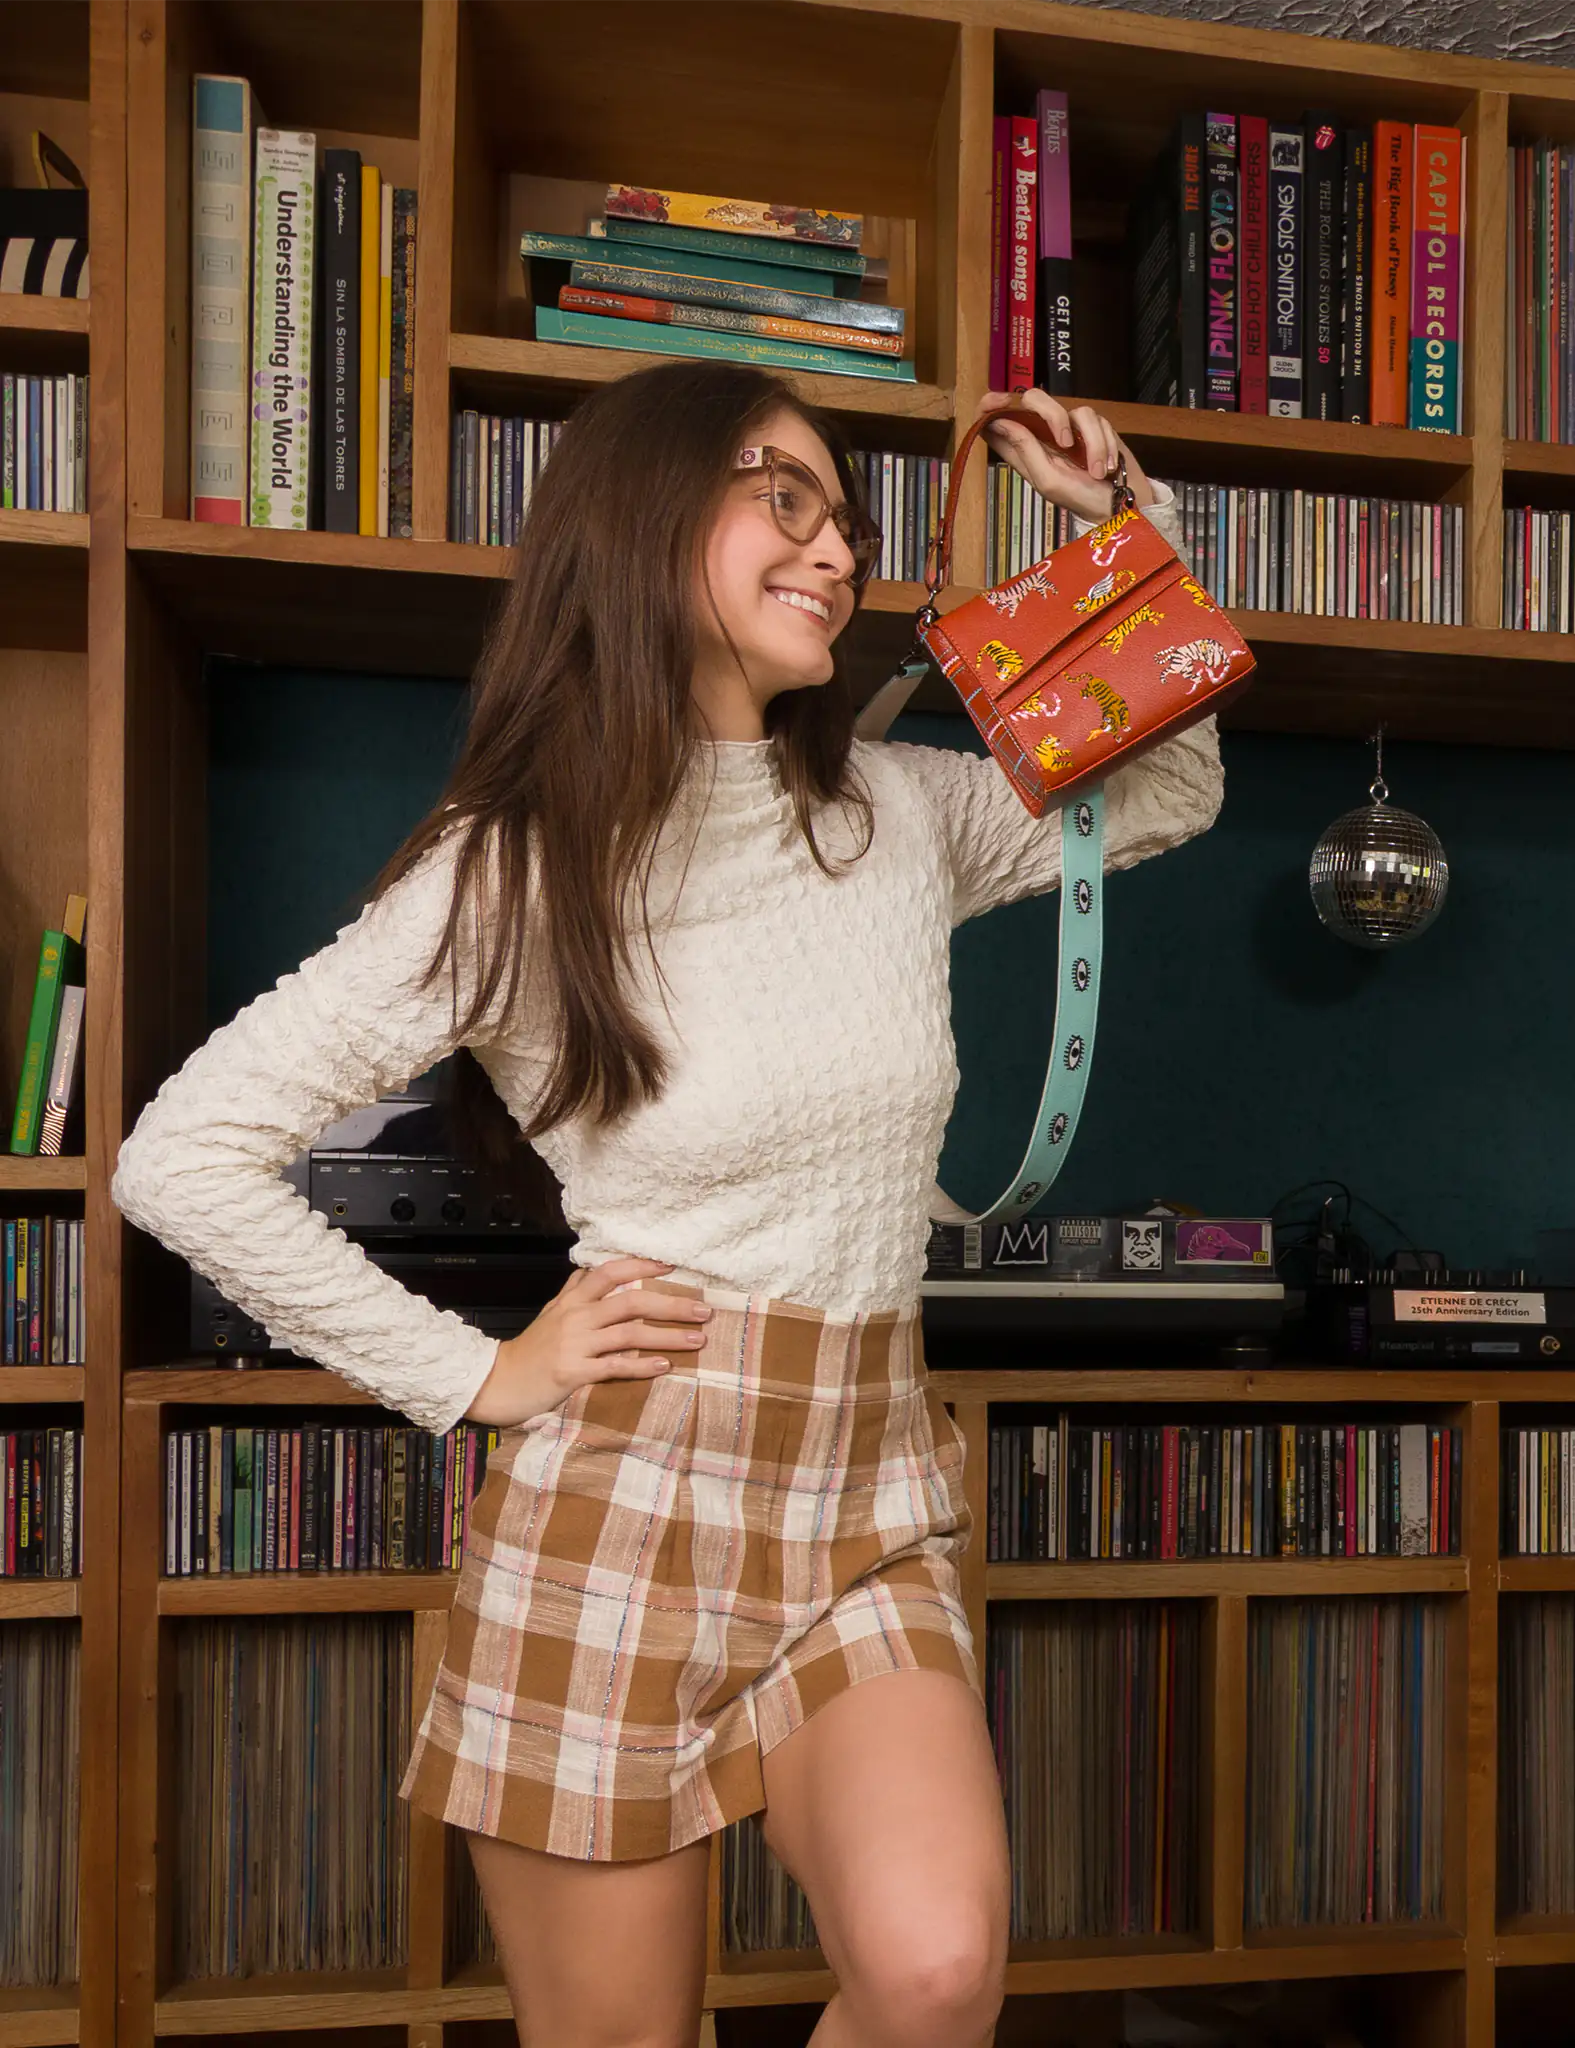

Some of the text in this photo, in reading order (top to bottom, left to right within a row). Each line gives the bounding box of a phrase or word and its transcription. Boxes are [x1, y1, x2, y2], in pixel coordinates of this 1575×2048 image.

[1047, 108, 1067, 154] BEATLES
[1390, 135, 1403, 163] The
[1184, 144, 1199, 211] THE CURE
[1387, 166, 1402, 192] Big
[1389, 195, 1402, 233] Book
[1010, 168, 1036, 302] Beatles songs
[1246, 141, 1262, 356] RED HOT CHILI PEPPERS
[1389, 236, 1402, 254] of
[1209, 188, 1235, 358] PINK FLOYD
[1277, 184, 1295, 326] ROLLING STONES
[1317, 180, 1332, 364] THE ROLLING STONES 50
[1354, 275, 1364, 312] STONES
[1425, 151, 1448, 417] CAPITOL RECORDS
[200, 148, 235, 483] STORIES
[1056, 295, 1071, 372] GET BACK
[1354, 315, 1363, 350] ROLLING
[269, 190, 298, 490] Understanding the World
[1353, 353, 1363, 376] THE
[334, 279, 347, 491] SIN LA SOMBRA DE LAS TORRES
[1061, 1226, 1099, 1237] ADVISORY
[1411, 1306, 1530, 1317] 25th Anniversary Edition
[1420, 1297, 1466, 1306] ETIENNE
[1469, 1297, 1482, 1306] DE
[268, 1433, 276, 1486] NIRVANA
[306, 1432, 315, 1455] RIESGO
[306, 1458, 315, 1481] PROPIO
[305, 1495, 315, 1509] BAJO
[305, 1512, 315, 1542] TRANSITE
